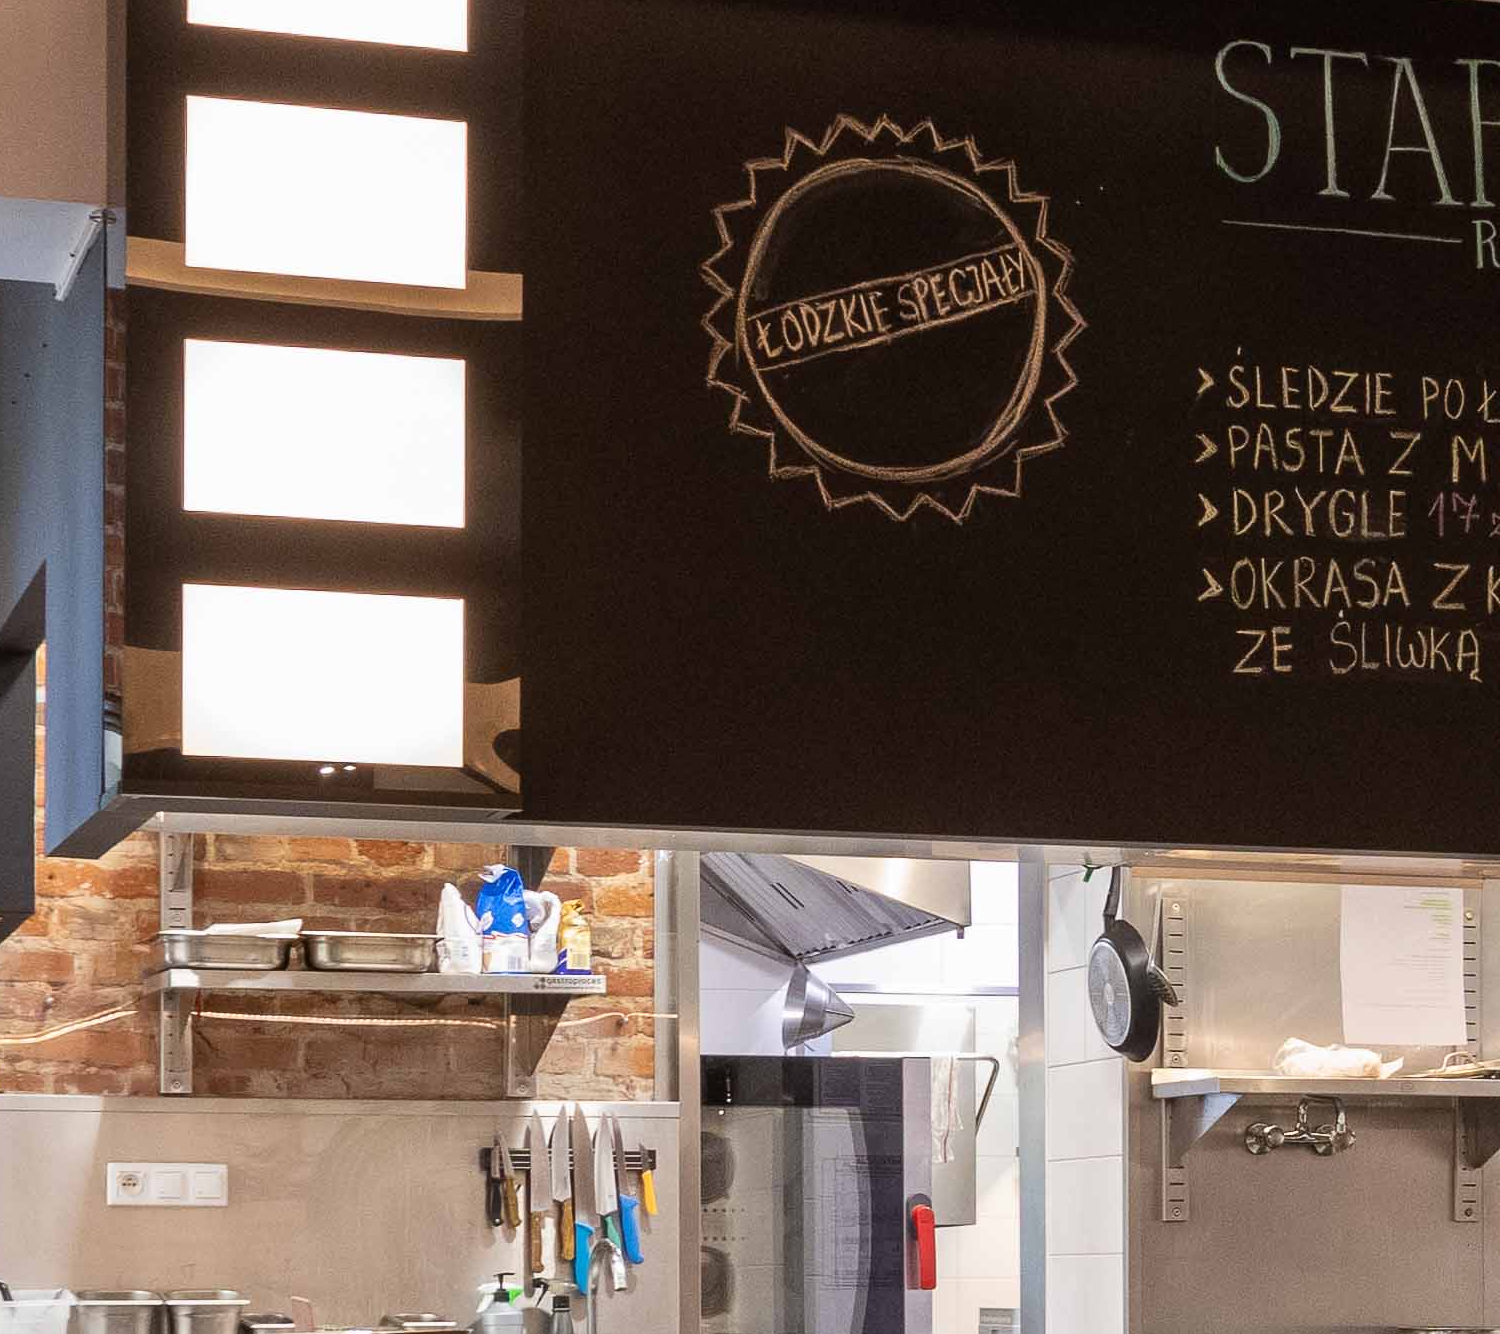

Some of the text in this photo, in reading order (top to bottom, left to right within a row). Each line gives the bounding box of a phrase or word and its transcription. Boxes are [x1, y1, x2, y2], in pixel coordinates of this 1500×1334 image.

[897, 252, 1026, 323] SPECJAŁY
[1225, 346, 1398, 415] ŚLEDZIE
[1422, 375, 1466, 421] PO
[1227, 424, 1366, 476] PASTA
[1387, 430, 1422, 475] Z
[1231, 486, 1408, 540] DRYGLE
[1427, 490, 1481, 538] 17
[1229, 556, 1411, 610] OKRASA
[1432, 562, 1471, 611] Z
[1232, 626, 1294, 674] ZE
[1329, 609, 1483, 684] ŚLIWKĄ
